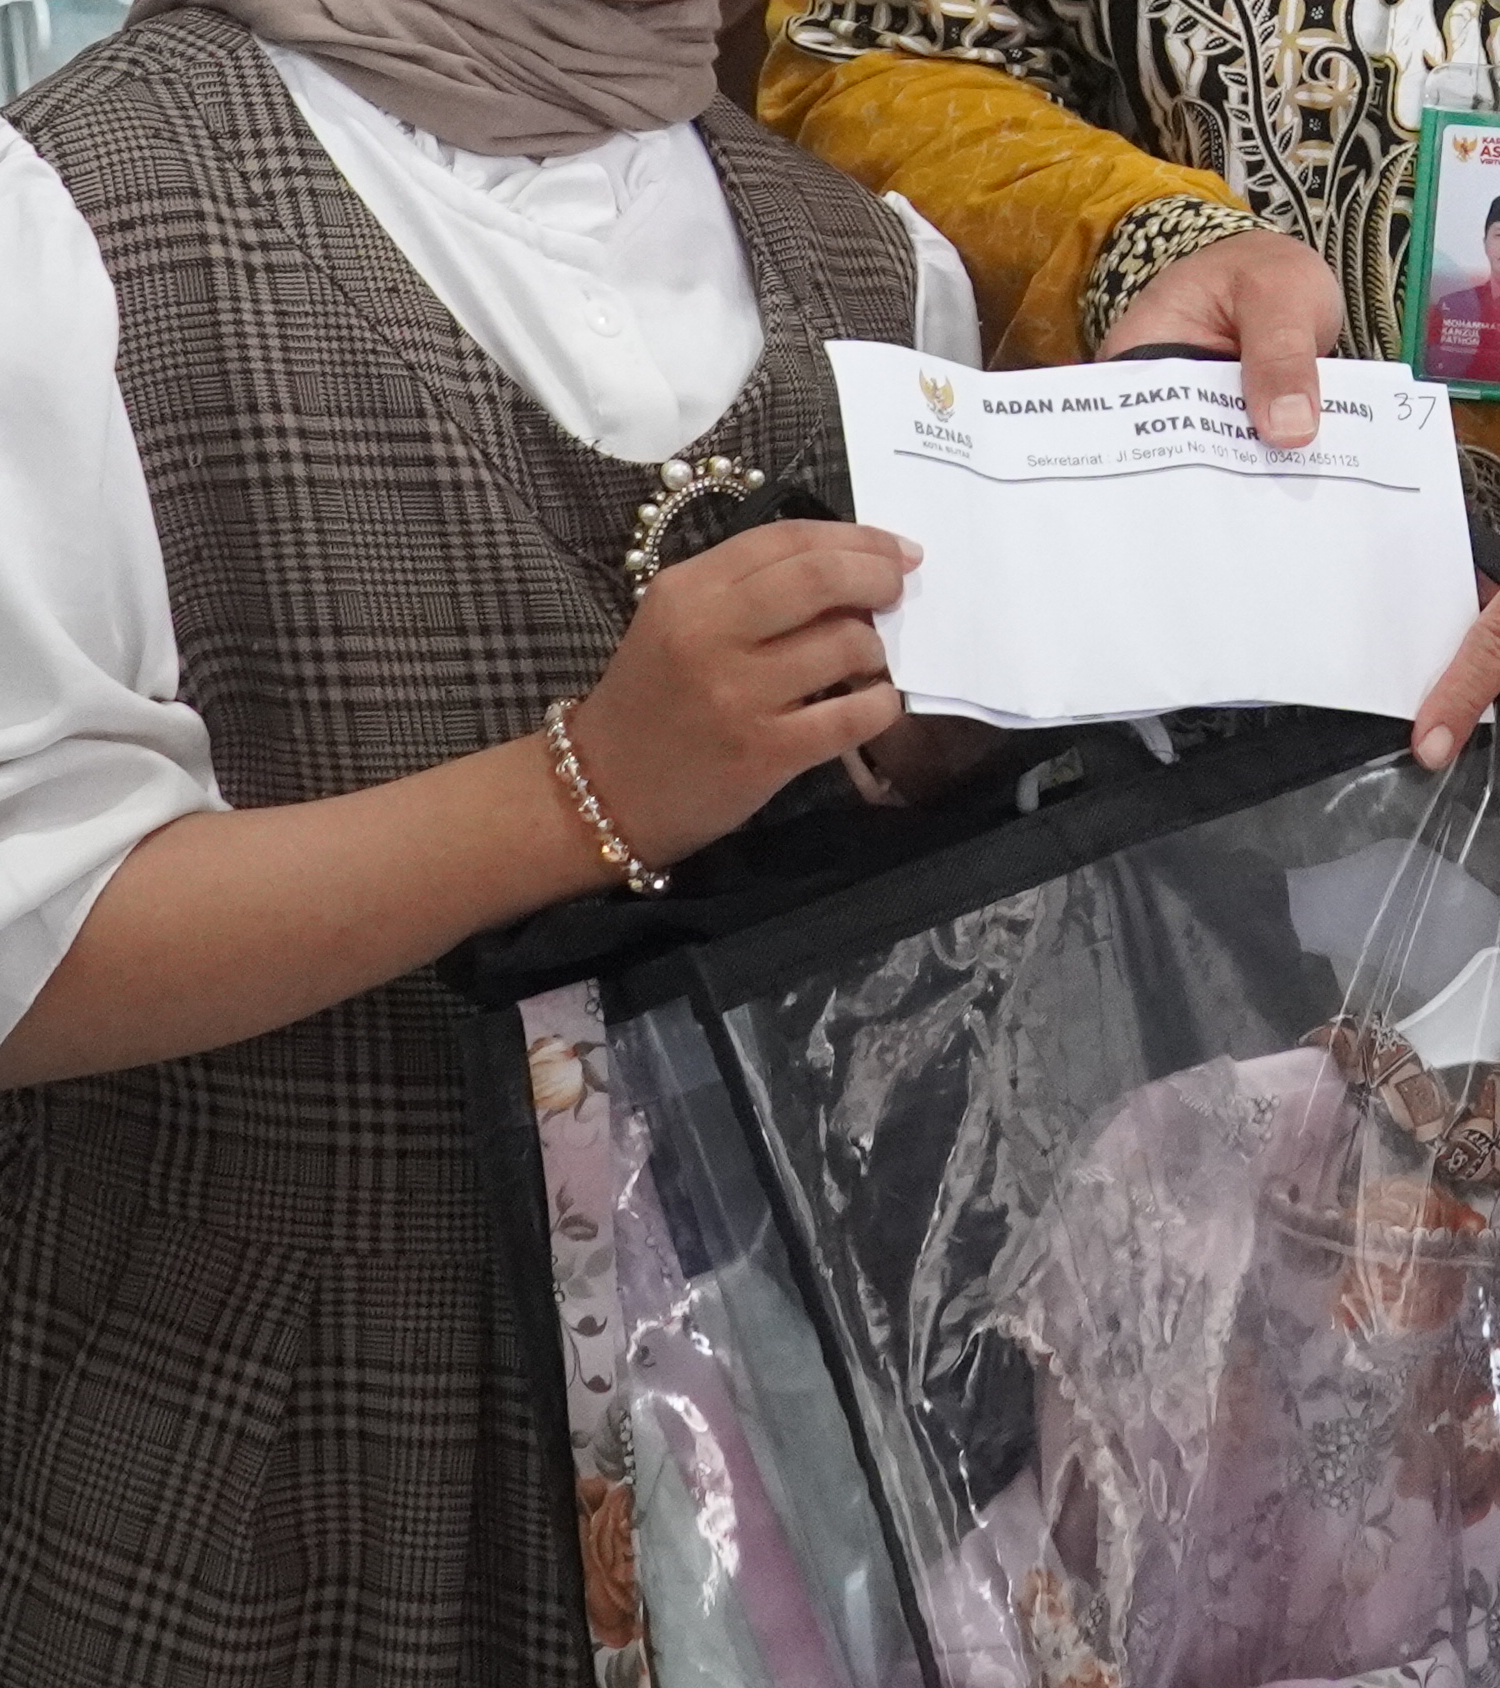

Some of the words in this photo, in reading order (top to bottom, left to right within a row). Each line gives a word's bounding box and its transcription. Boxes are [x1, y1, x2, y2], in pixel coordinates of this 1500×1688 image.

[982, 398, 1054, 414] BADAN
[1061, 396, 1113, 413] AMIL
[1119, 386, 1191, 408] ZAKAT
[1197, 387, 1248, 411] NASIO
[1320, 399, 1373, 421] ZNAS)
[1394, 392, 1436, 430] 37
[914, 420, 974, 449] BAZNAS
[1133, 415, 1196, 436] KOTA
[1199, 416, 1261, 441] BLITAR
[1027, 452, 1103, 467] Sekretariat
[1131, 444, 1184, 461] Serayu
[1211, 444, 1230, 458] 101
[1265, 450, 1306, 465] (0342)
